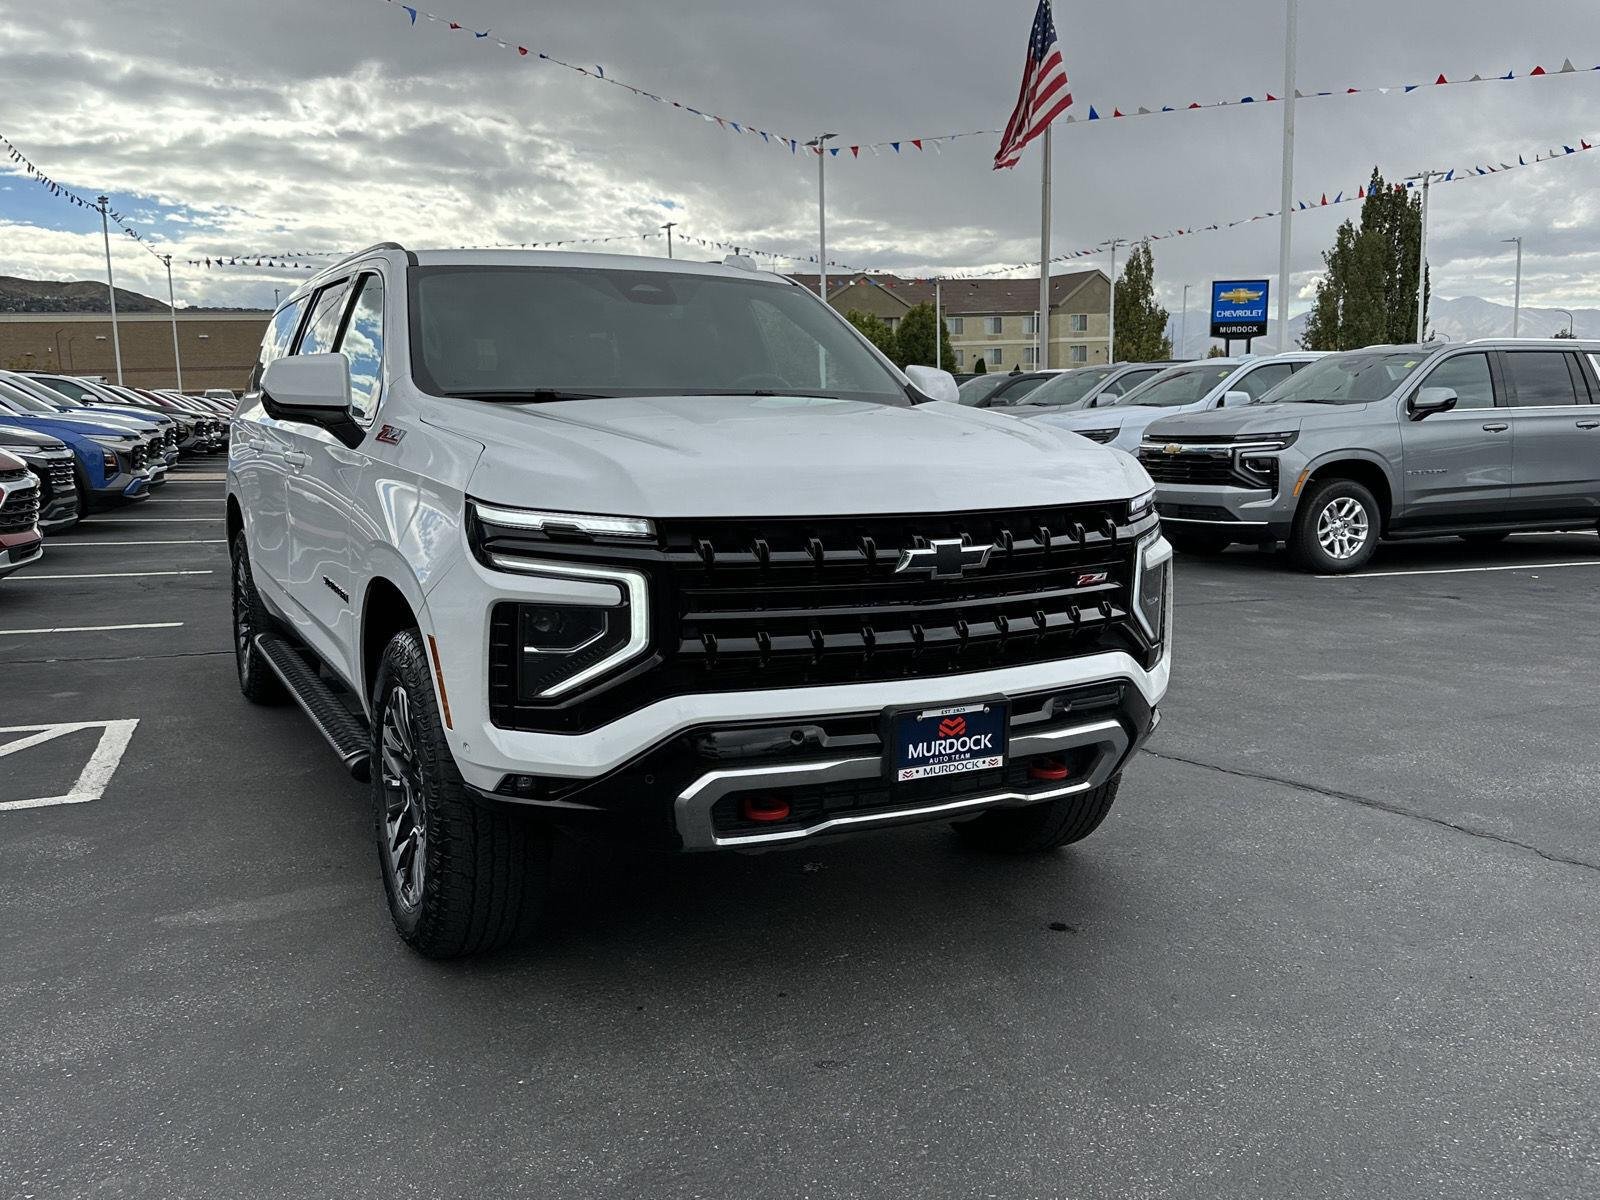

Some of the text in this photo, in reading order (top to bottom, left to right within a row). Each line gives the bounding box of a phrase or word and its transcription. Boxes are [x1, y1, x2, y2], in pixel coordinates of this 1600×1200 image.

[1216, 309, 1263, 318] CHEVROLET
[1219, 325, 1258, 333] MURDOCK
[908, 733, 993, 759] MURDOCK
[929, 752, 971, 764] AUTO TEAM
[923, 760, 980, 776] MURDOCK
